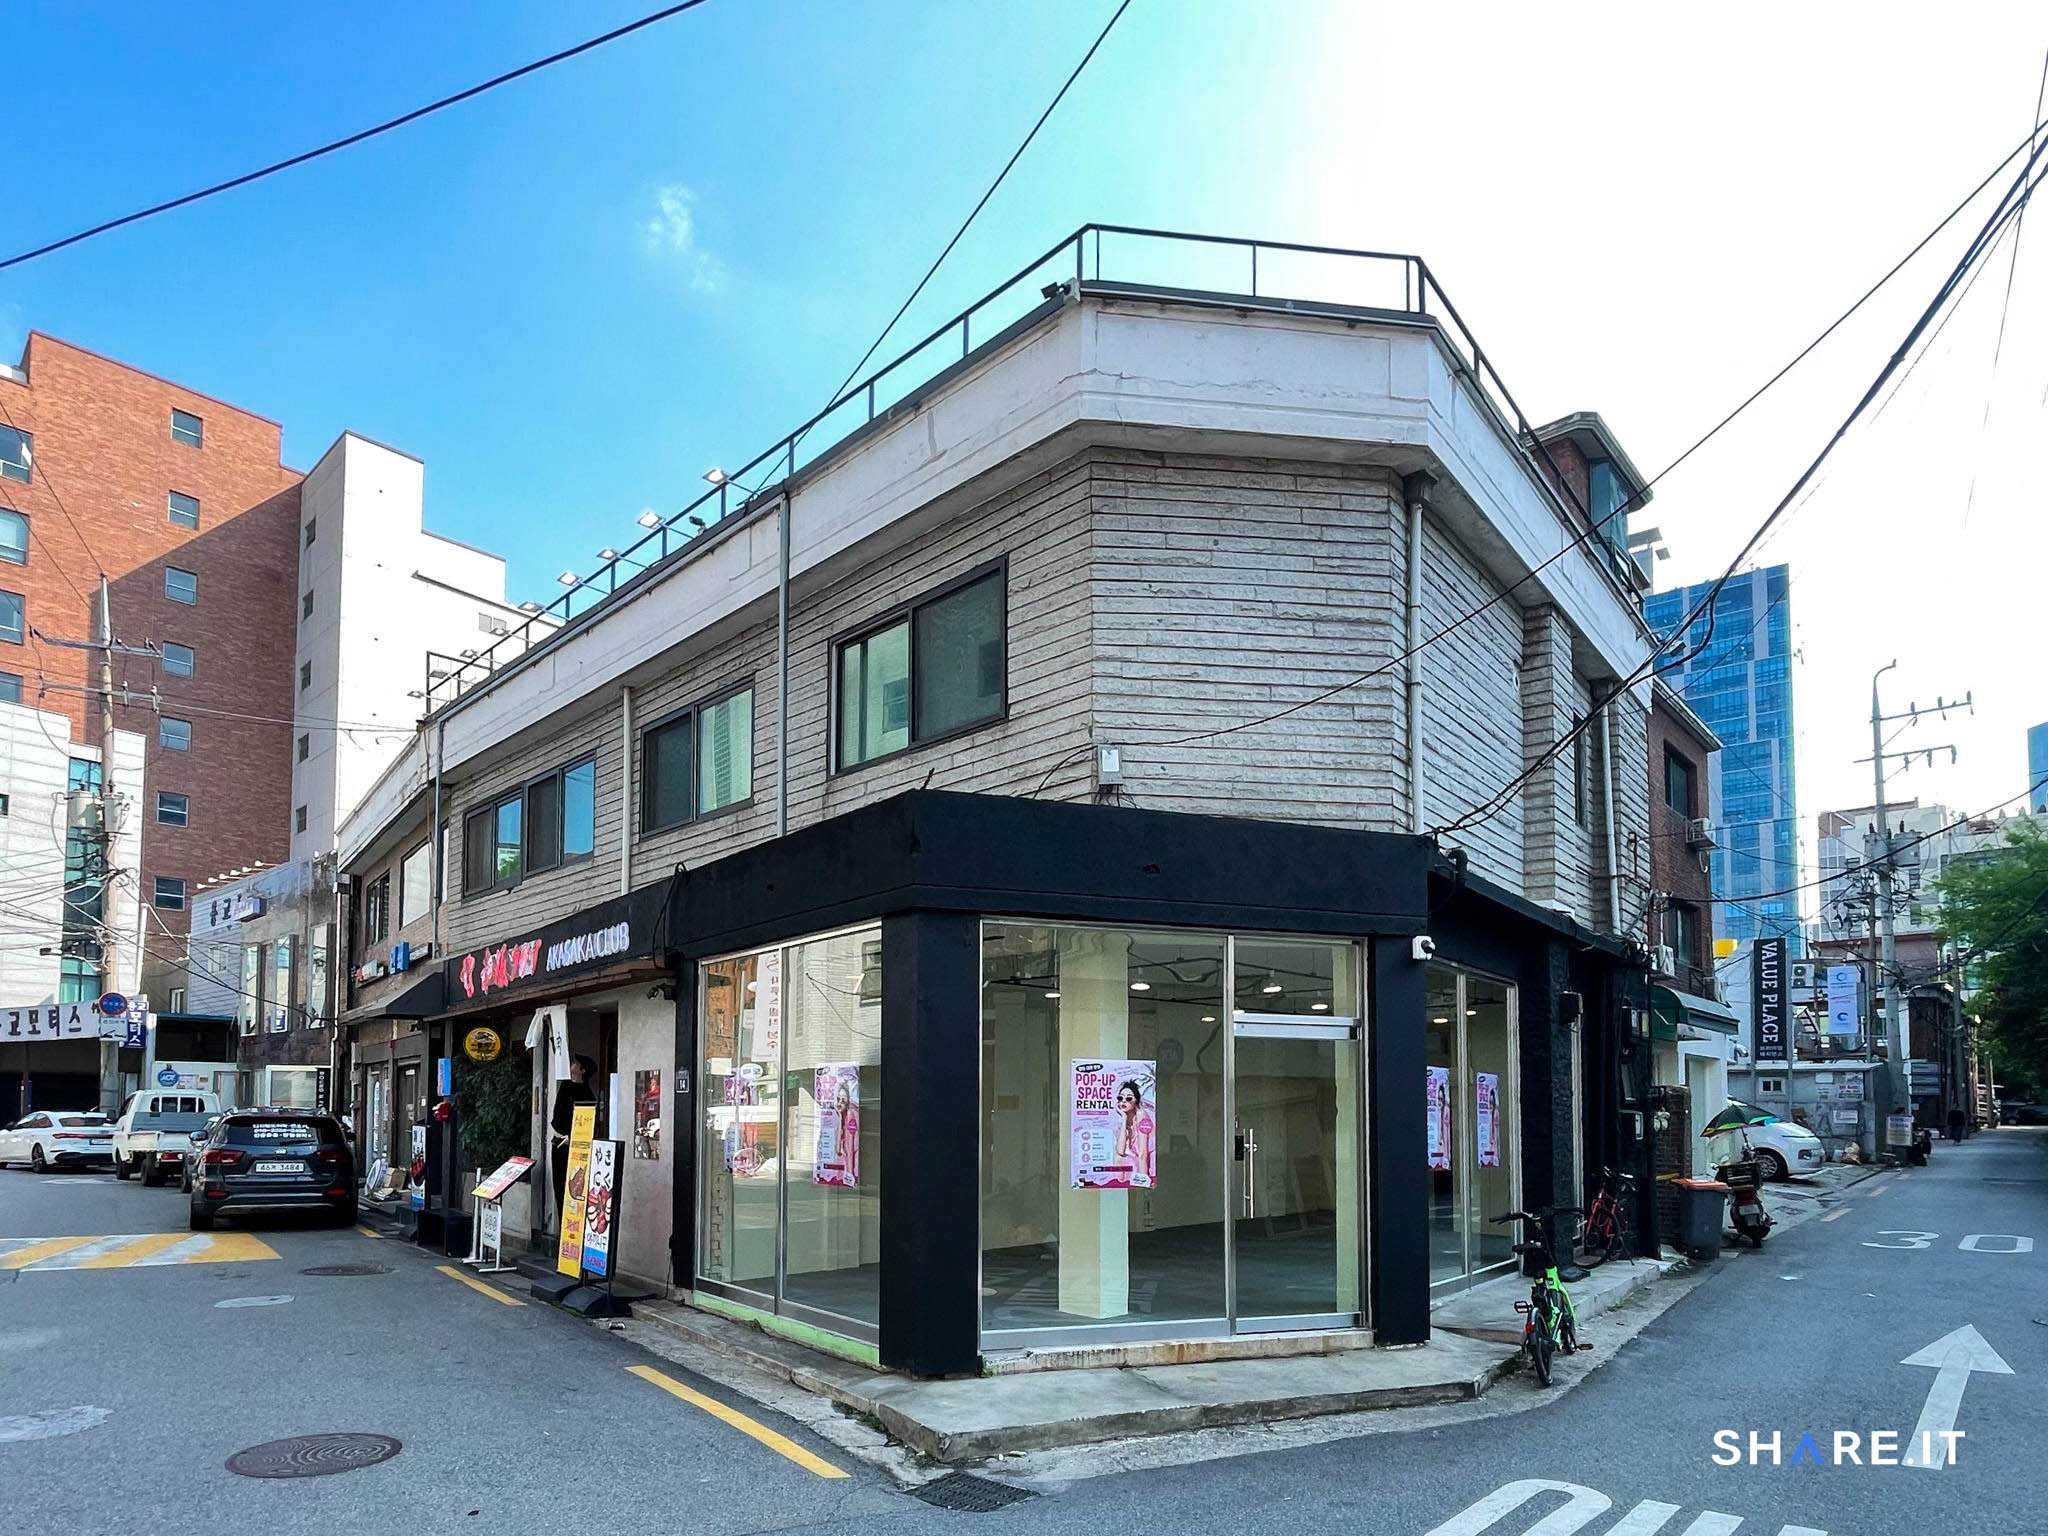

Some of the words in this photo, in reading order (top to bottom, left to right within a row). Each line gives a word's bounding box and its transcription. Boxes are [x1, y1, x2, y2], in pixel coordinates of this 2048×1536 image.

[1760, 941, 1778, 990] VALUE
[1762, 993, 1779, 1043] PLACE
[1075, 1073, 1116, 1086] POP-UP
[1078, 1086, 1113, 1100] SPACE
[1076, 1100, 1114, 1109] RENTAL
